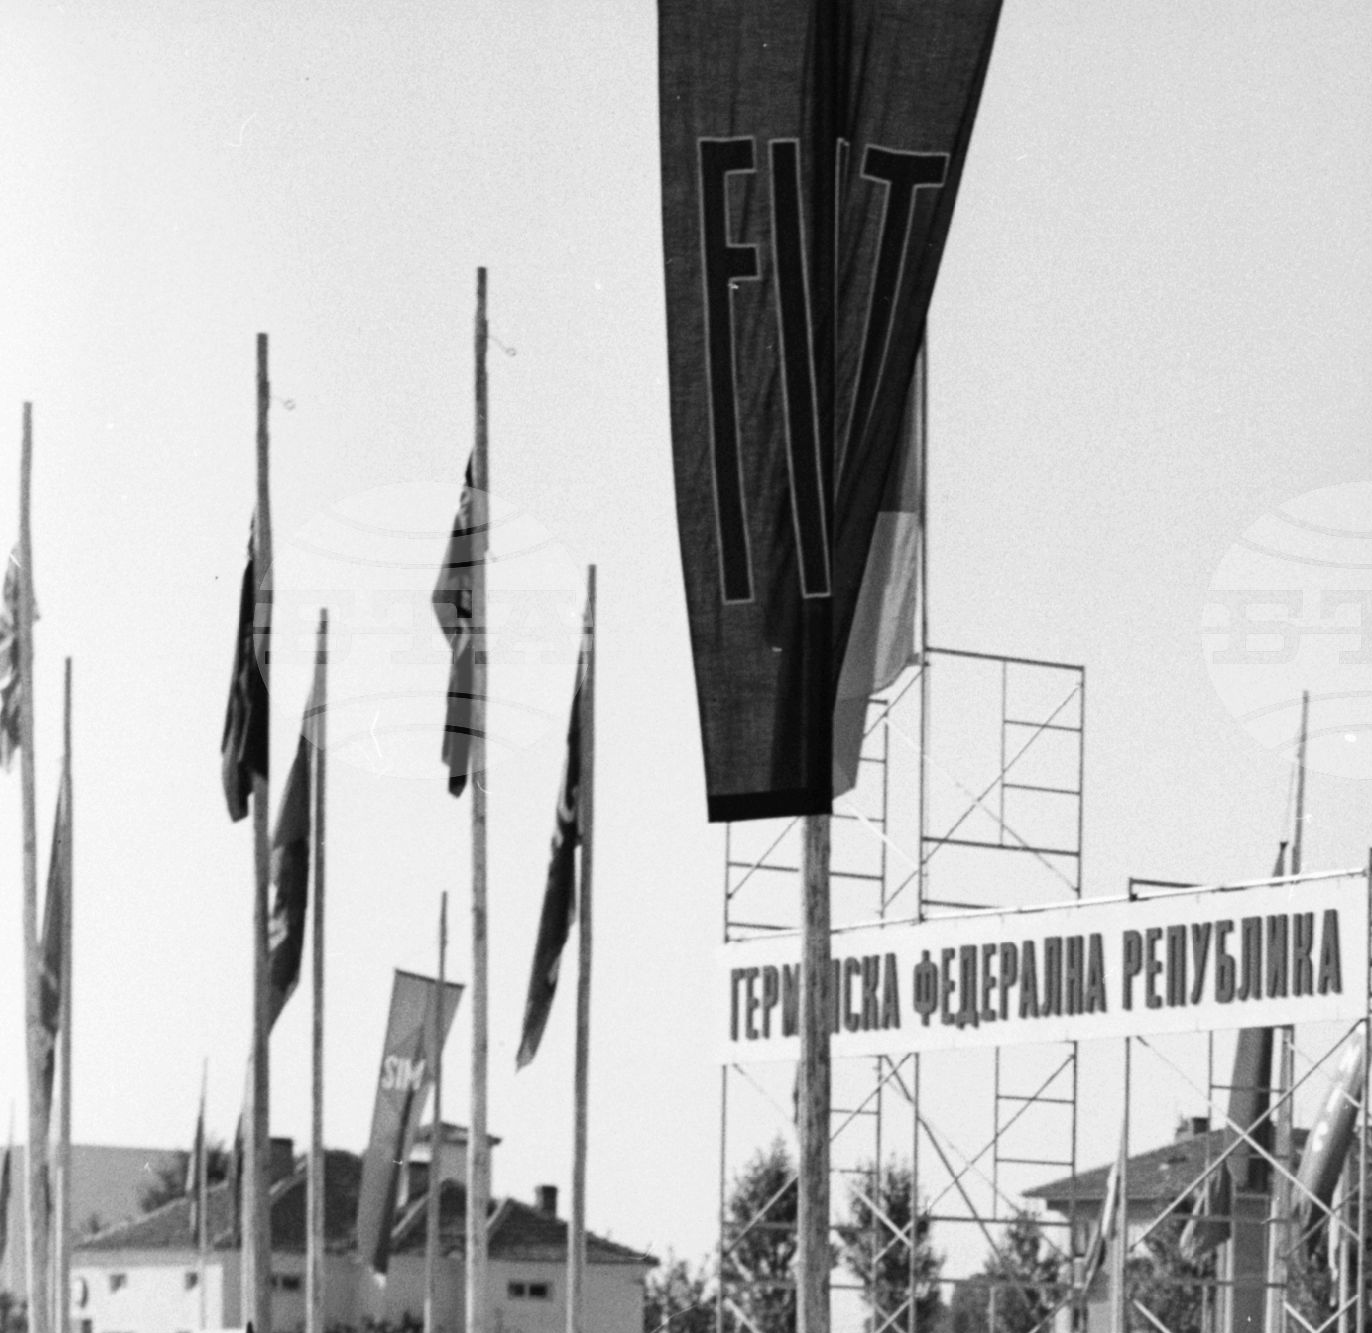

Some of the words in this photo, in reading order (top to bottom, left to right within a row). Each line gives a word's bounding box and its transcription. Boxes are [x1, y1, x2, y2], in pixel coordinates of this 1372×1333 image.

[697, 136, 951, 605] FIT
[730, 952, 901, 1042] ГЕРМСКА
[912, 931, 1108, 1029] ФЕДЕРАЛНА
[1122, 908, 1343, 1011] РЕПУБЛИКА
